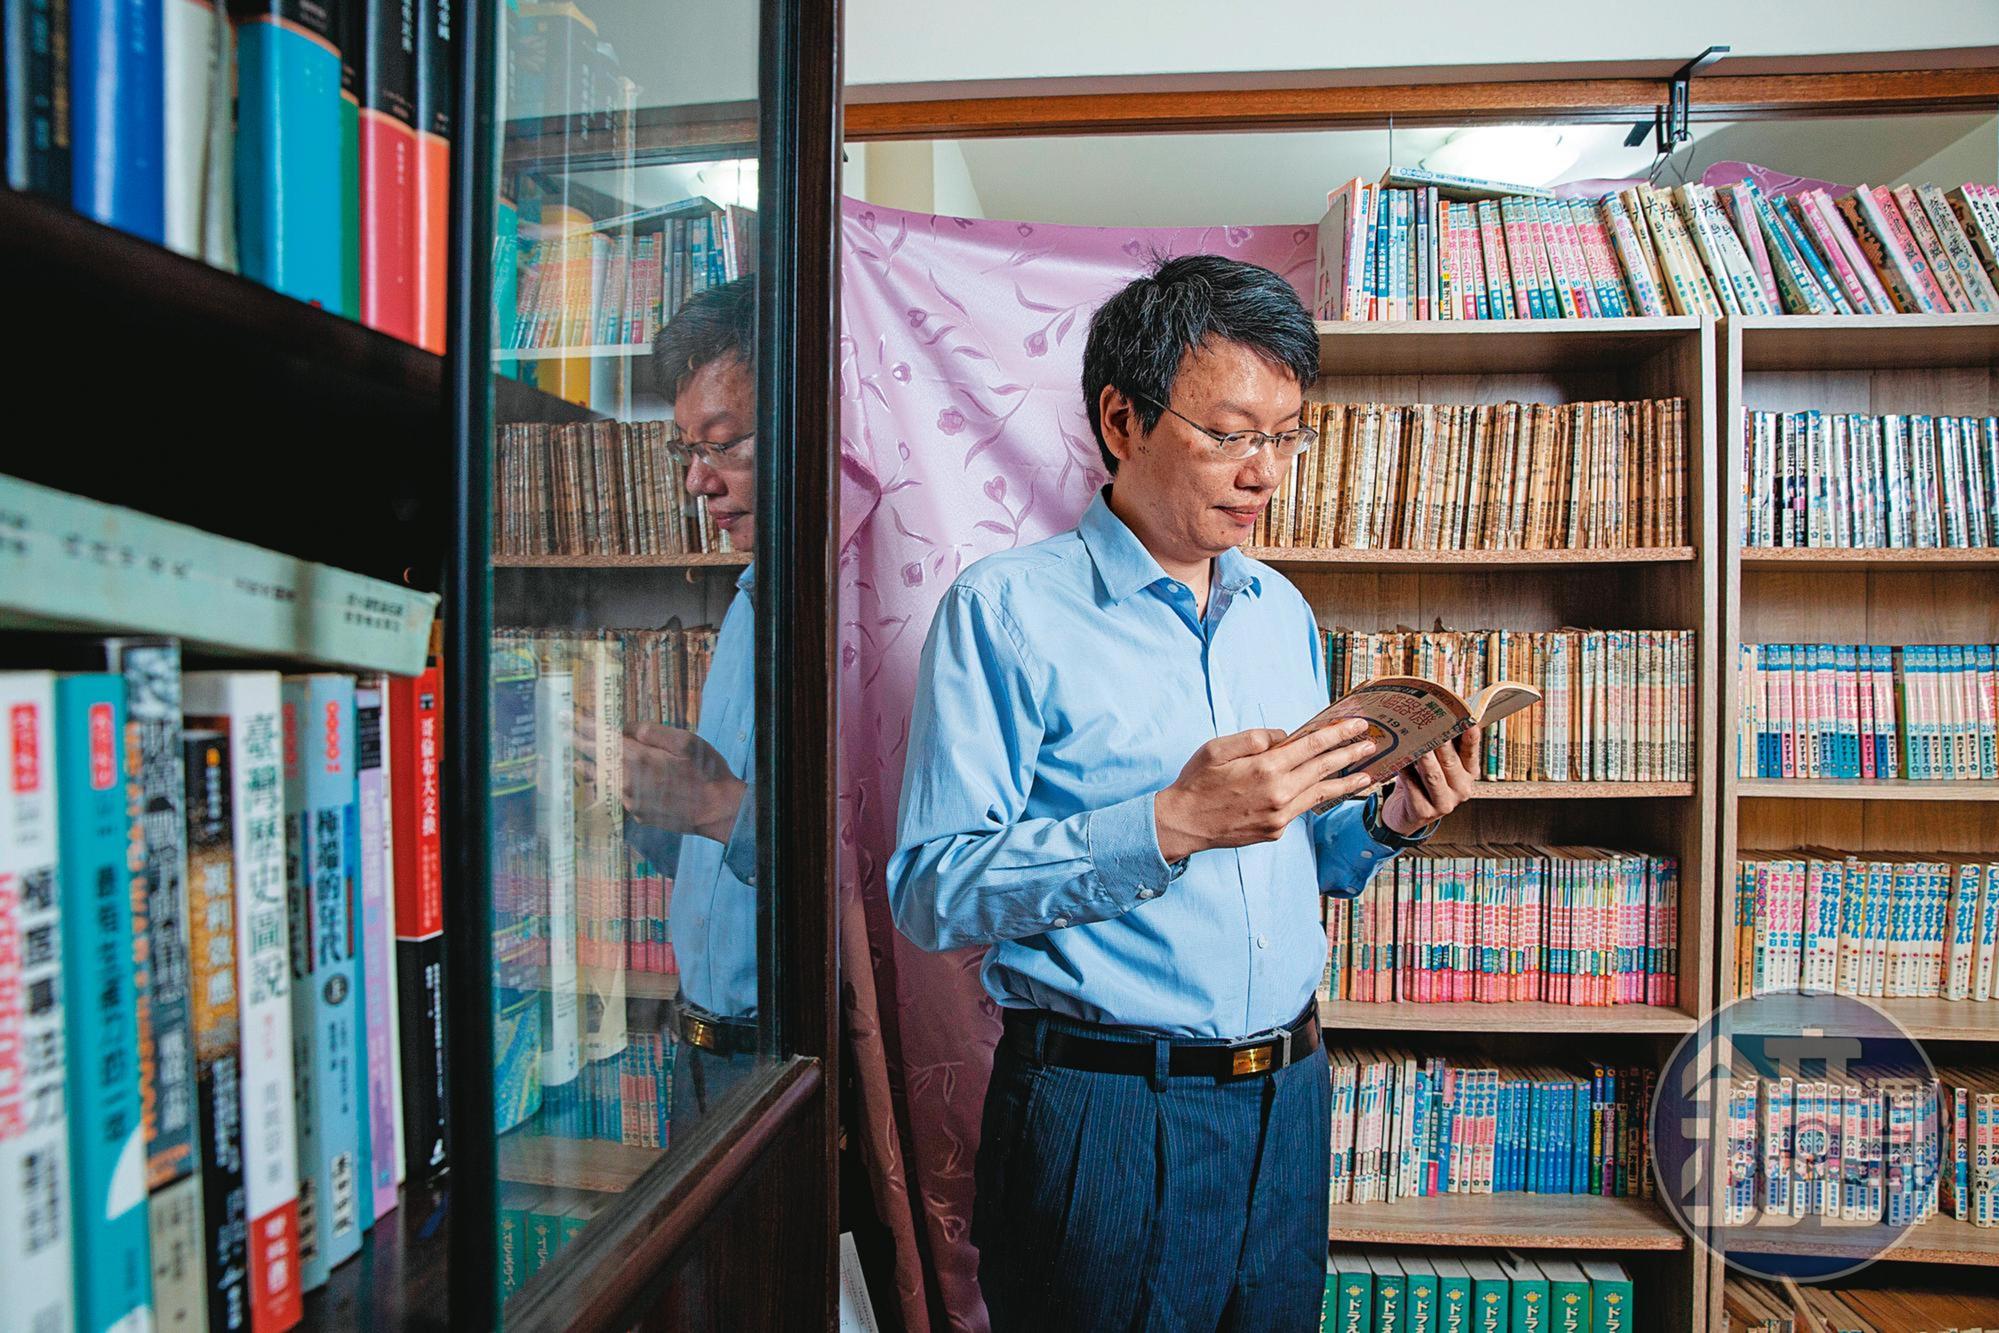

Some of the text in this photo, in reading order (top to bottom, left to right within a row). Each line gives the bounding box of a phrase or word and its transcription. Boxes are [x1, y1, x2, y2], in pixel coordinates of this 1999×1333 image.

[1484, 1306, 1498, 1333] ドラ
[1525, 1305, 1539, 1333] ドラ
[1564, 1307, 1578, 1333] ドラ
[1606, 1307, 1620, 1333] ドラ
